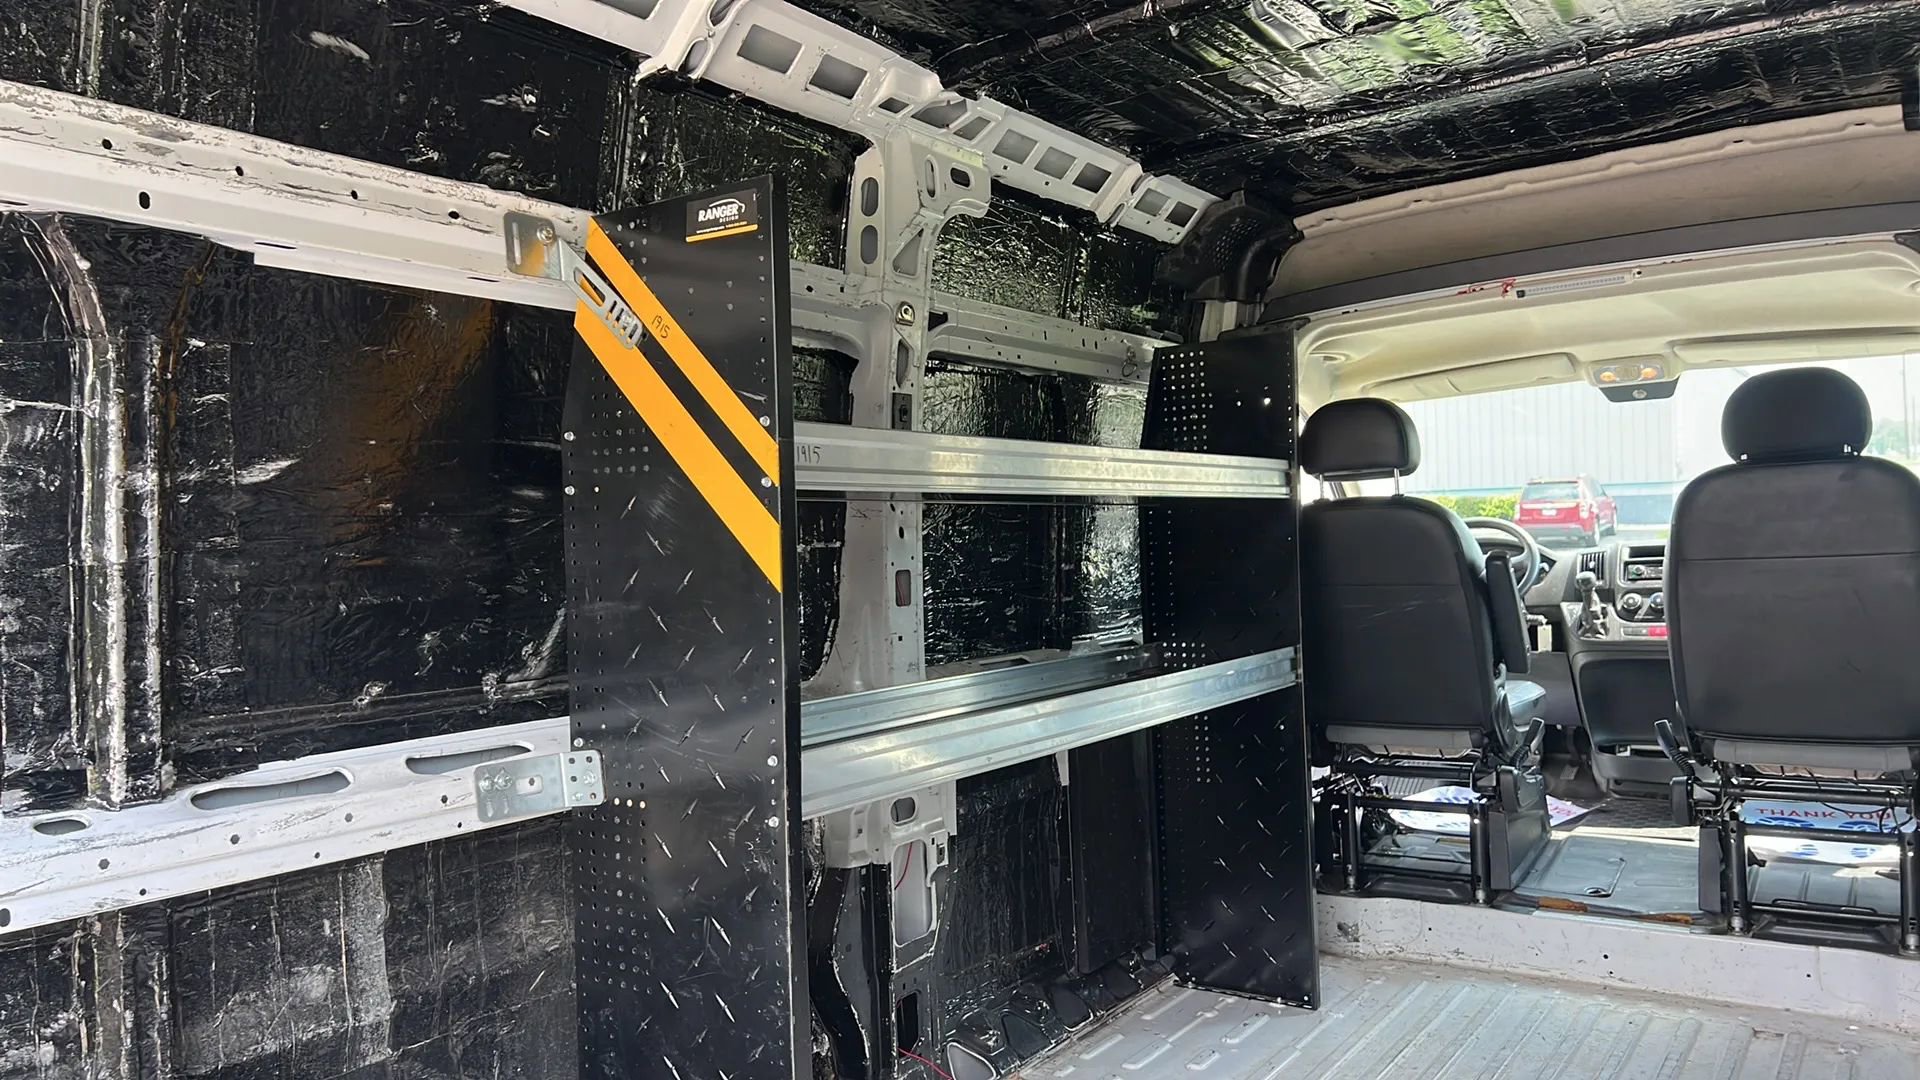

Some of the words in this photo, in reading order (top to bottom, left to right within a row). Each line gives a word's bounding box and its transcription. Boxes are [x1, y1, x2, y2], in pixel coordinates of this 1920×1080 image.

[698, 204, 739, 222] RANGER
[652, 314, 671, 339] 1915
[797, 445, 821, 464] 1915
[1755, 808, 1837, 818] THANK
